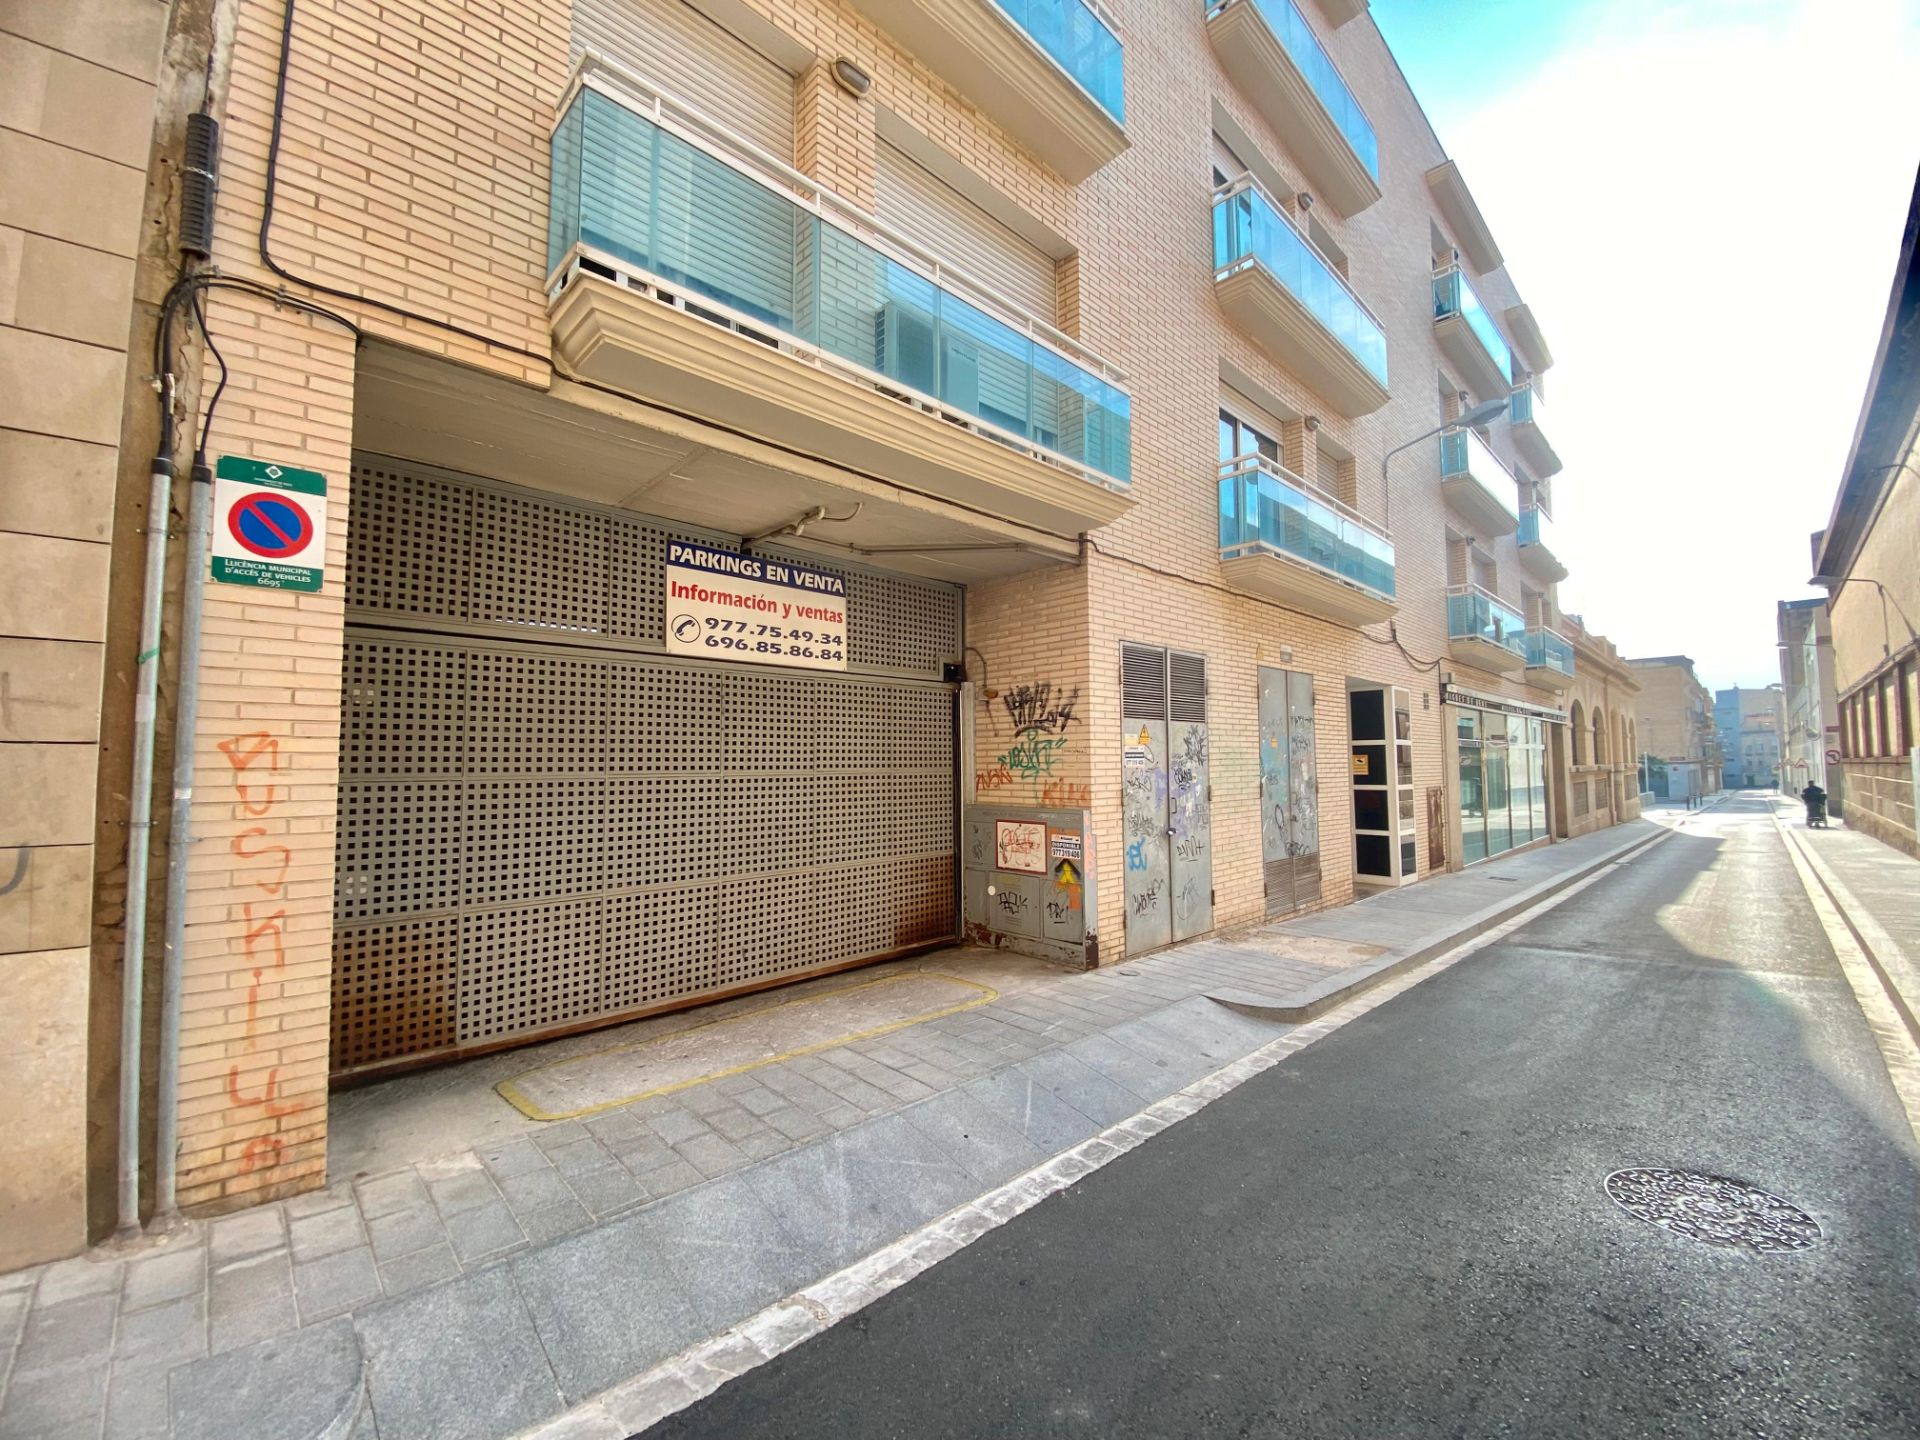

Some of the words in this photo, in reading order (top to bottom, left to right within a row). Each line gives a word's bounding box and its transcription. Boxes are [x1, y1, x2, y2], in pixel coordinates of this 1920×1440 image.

[257, 577, 280, 588] 6695
[268, 565, 312, 575] MUNICIPAL
[274, 573, 311, 583] VEHICLES
[669, 544, 762, 578] PARKINGS
[766, 565, 789, 583] EN
[793, 572, 844, 594] VENTA
[671, 581, 777, 613] Información
[782, 602, 792, 619] y
[796, 605, 843, 624] ventas
[705, 617, 843, 646] 977.75.49.34
[705, 635, 843, 662] 696.85.86.84
